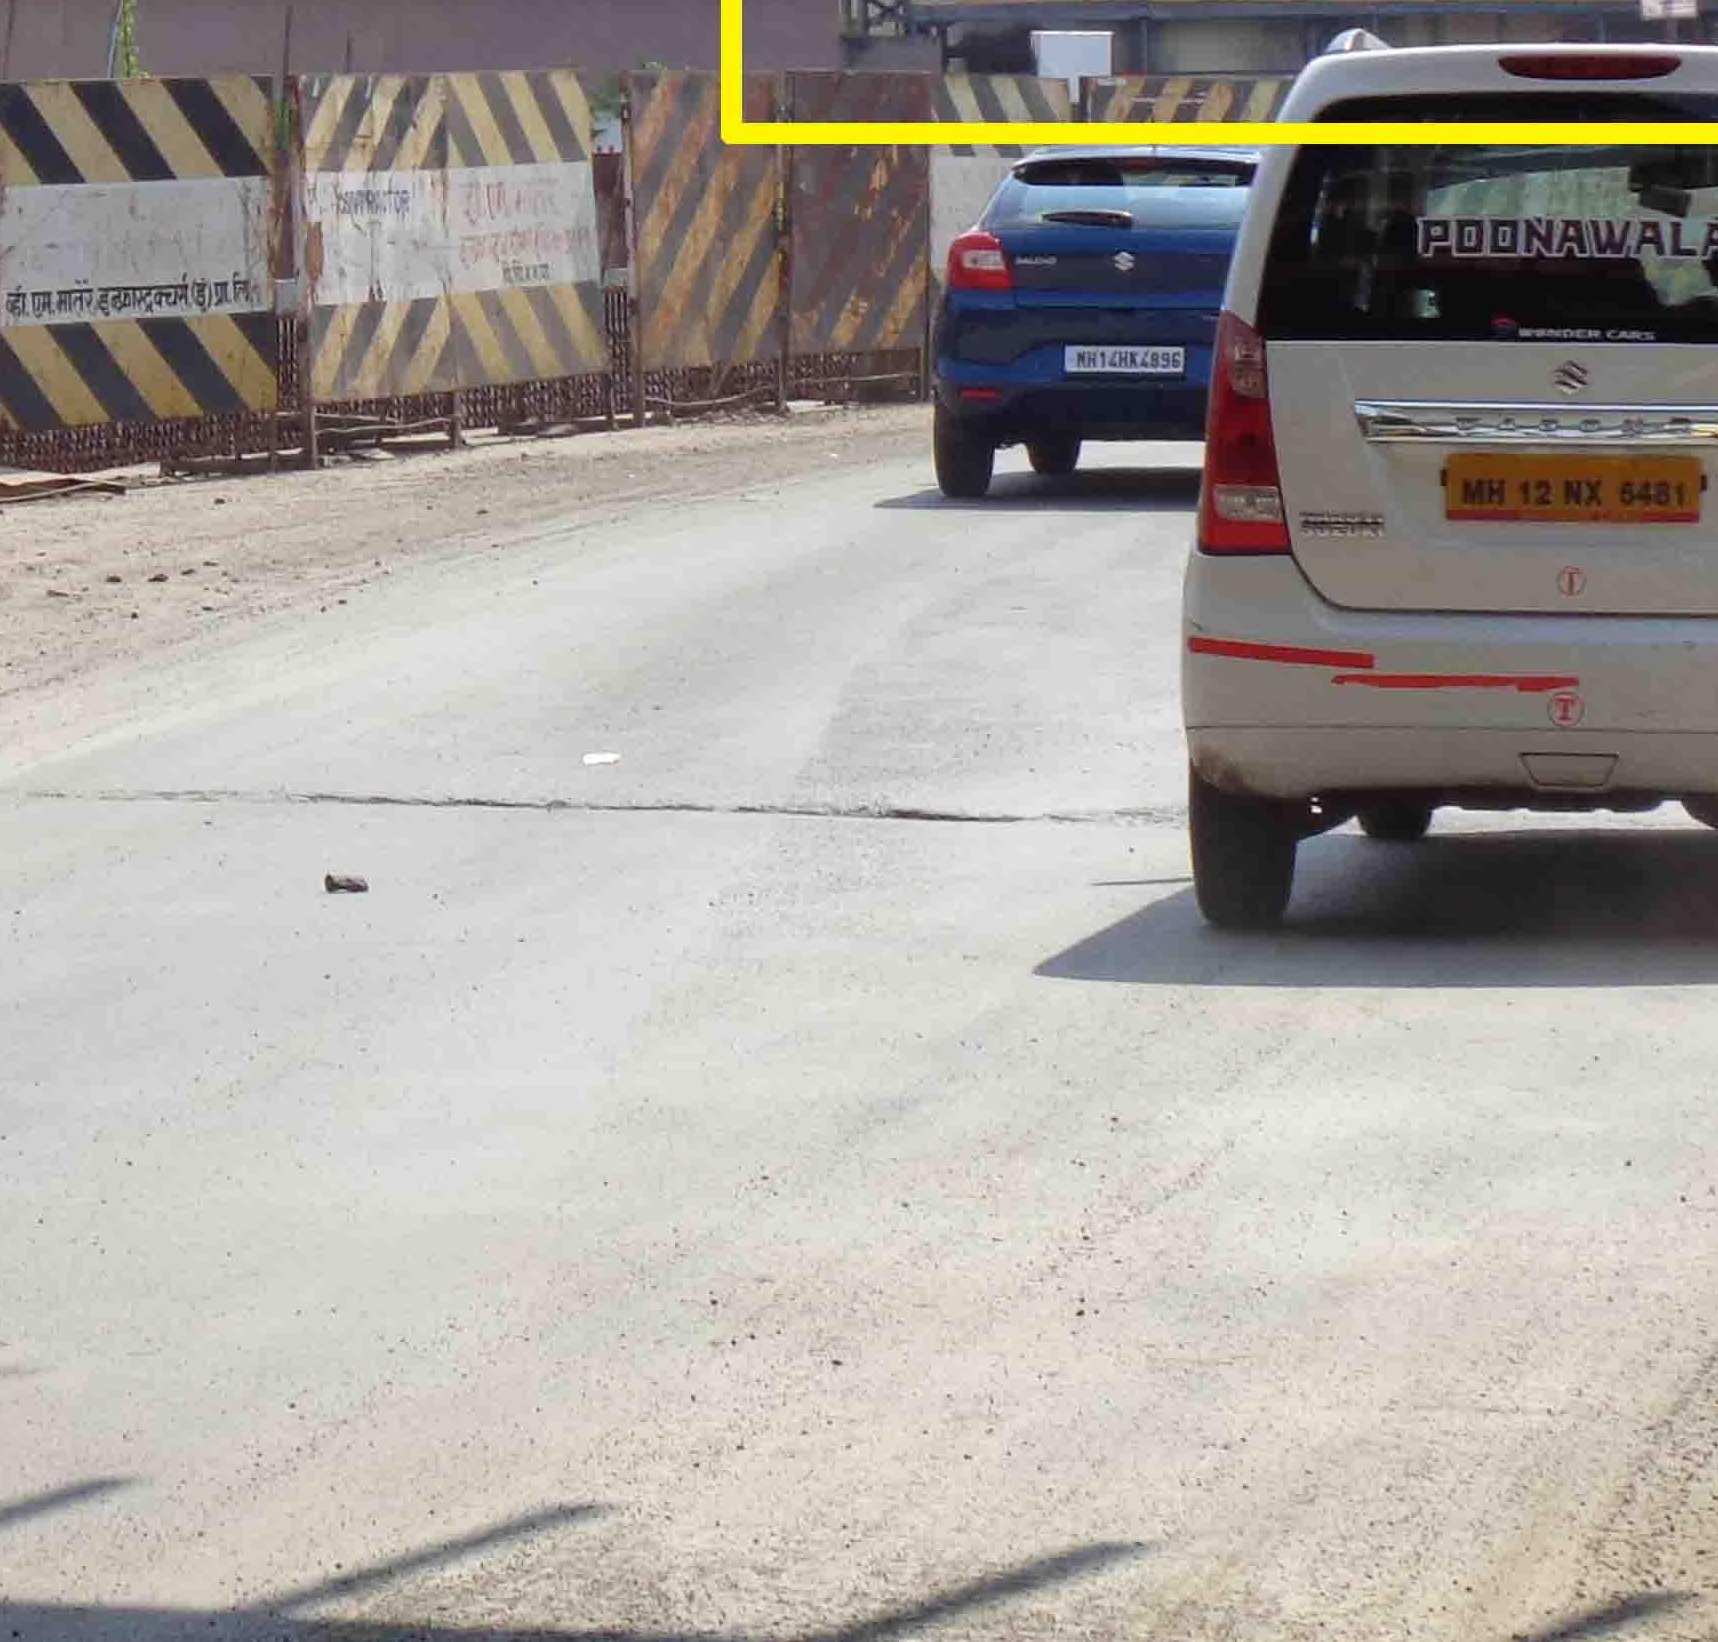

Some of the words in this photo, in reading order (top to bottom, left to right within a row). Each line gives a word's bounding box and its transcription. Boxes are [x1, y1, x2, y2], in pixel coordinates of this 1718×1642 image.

[1518, 325, 1601, 341] WONDER
[1606, 328, 1657, 342] CARS
[1462, 478, 1506, 507] MH
[1518, 478, 1550, 507] 12
[1563, 478, 1603, 507] NX
